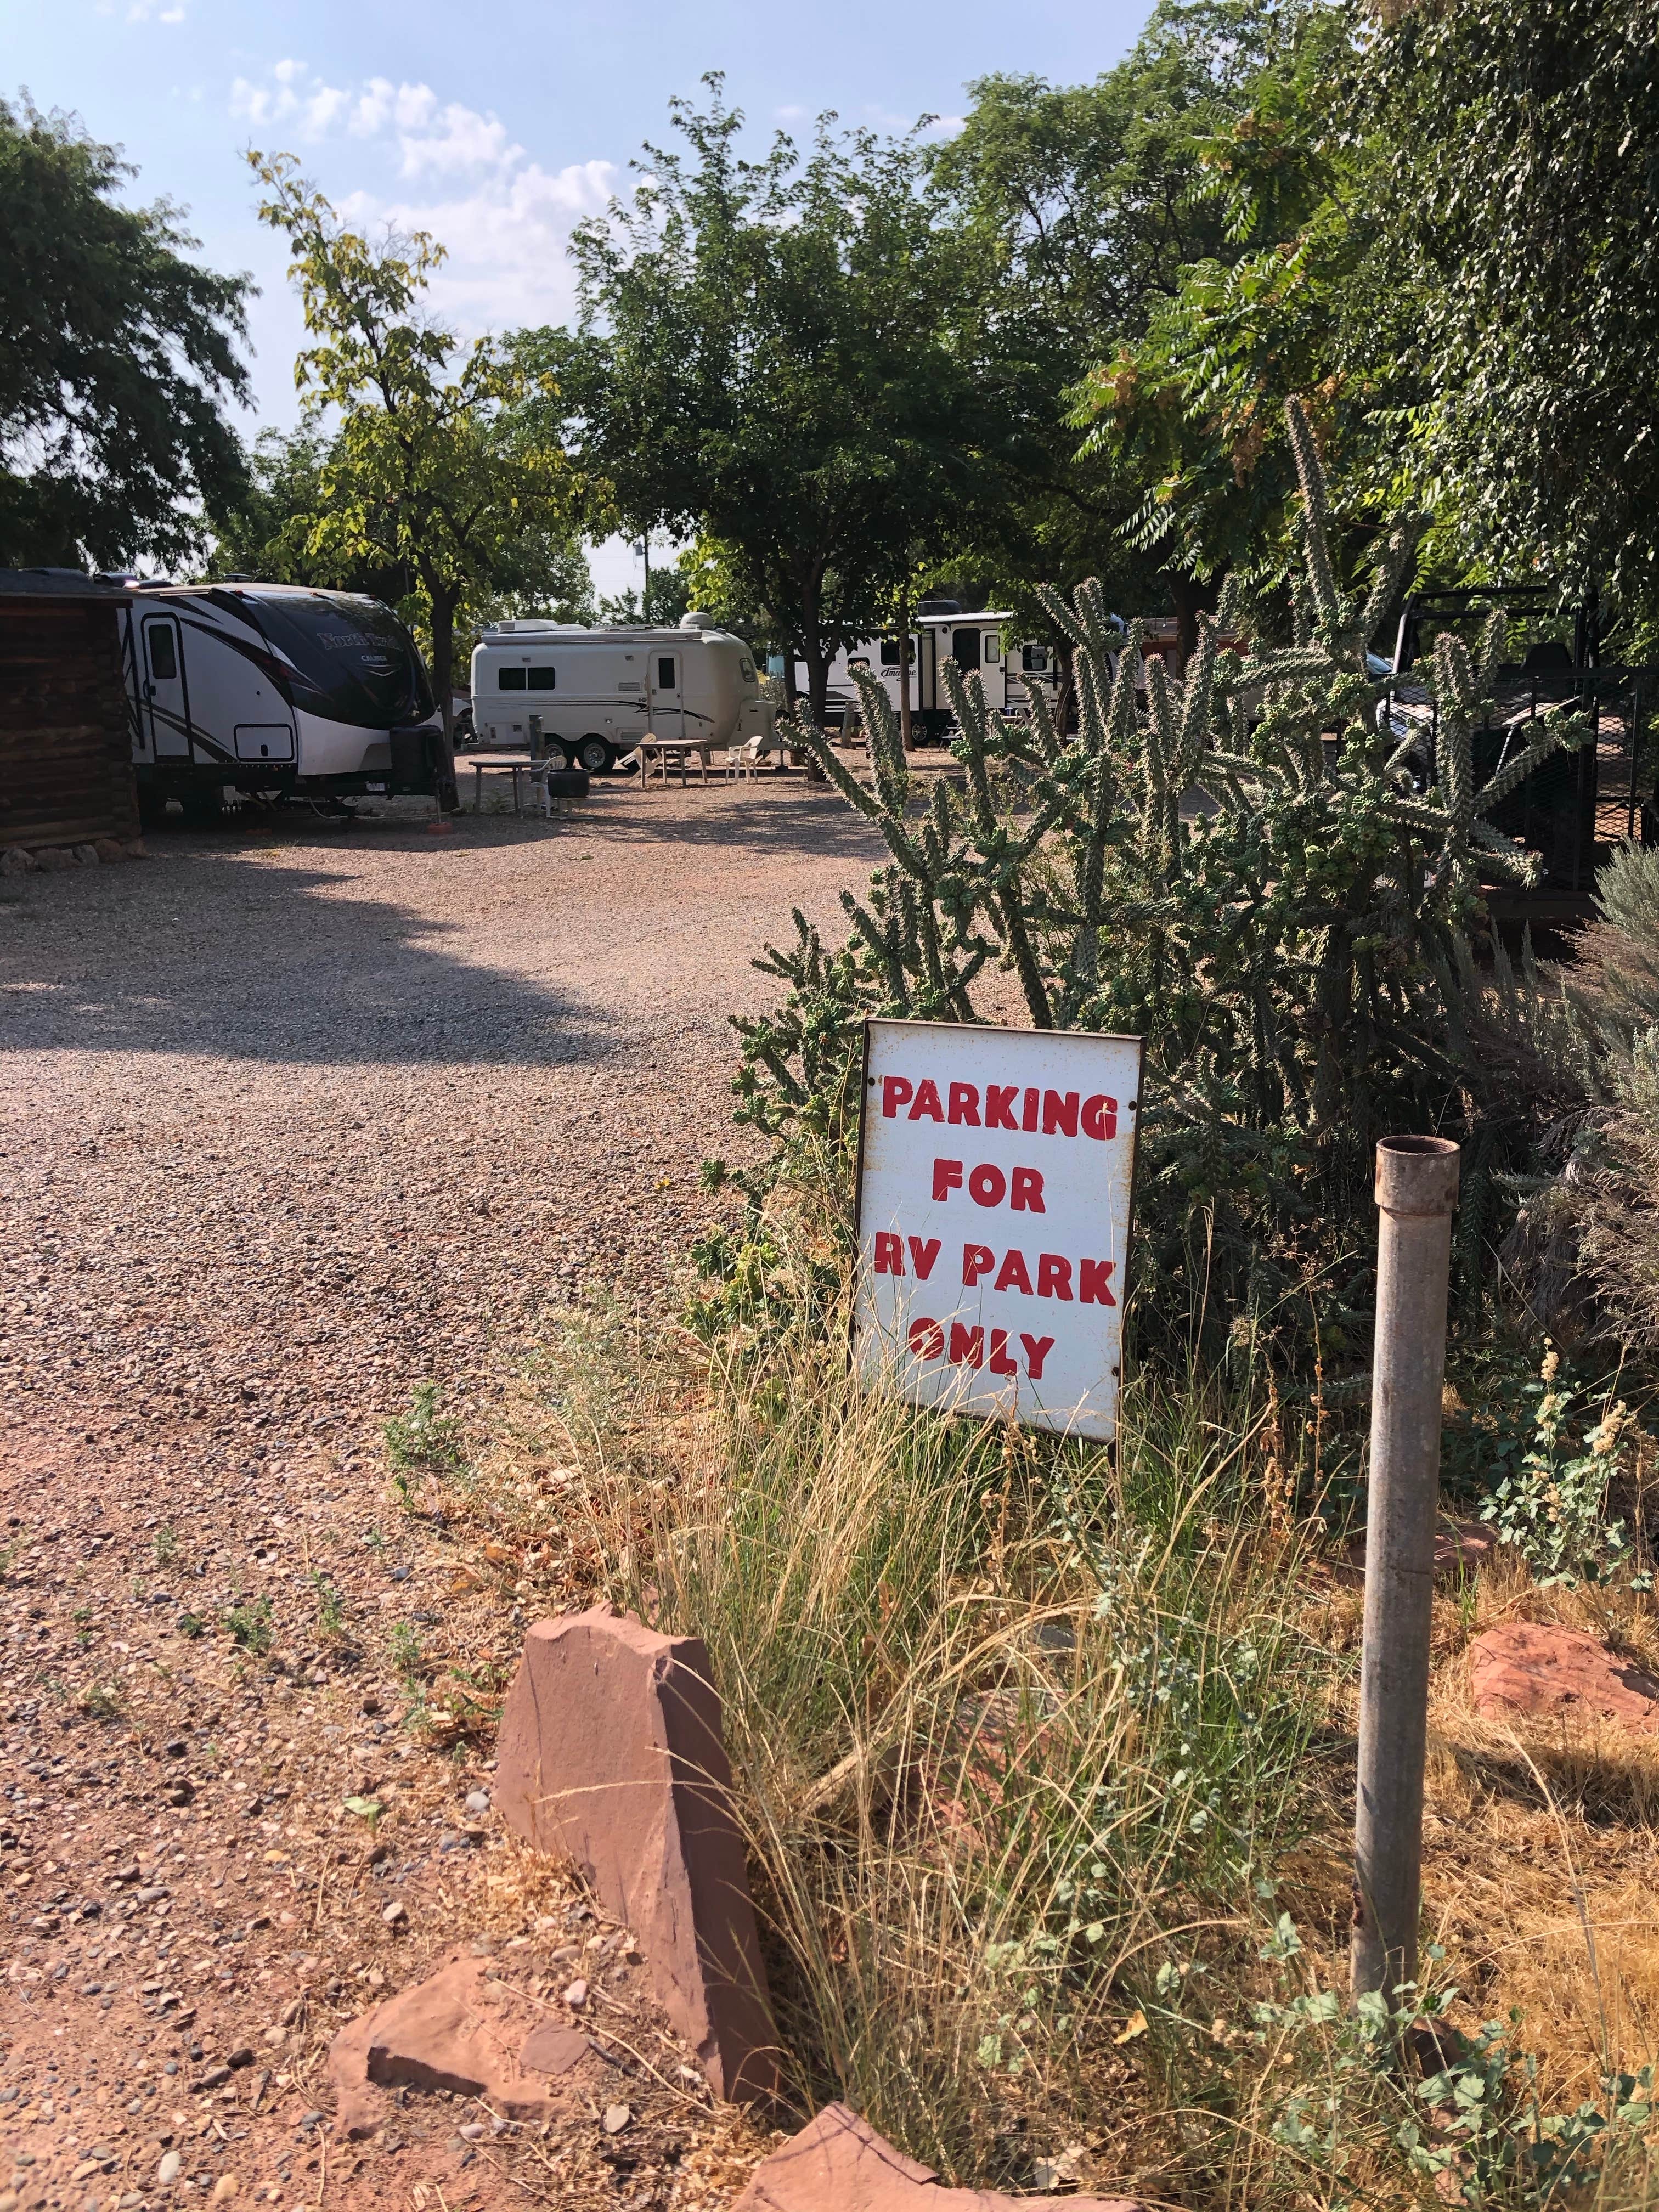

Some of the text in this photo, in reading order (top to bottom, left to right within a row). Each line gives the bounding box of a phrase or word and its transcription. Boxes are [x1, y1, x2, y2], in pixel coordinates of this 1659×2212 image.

[884, 667, 916, 681] Imane
[883, 1076, 1118, 1140] PARKING
[933, 1159, 1045, 1213] FOR
[874, 1232, 1116, 1306] RV PARK
[909, 1318, 1054, 1379] ONLY
